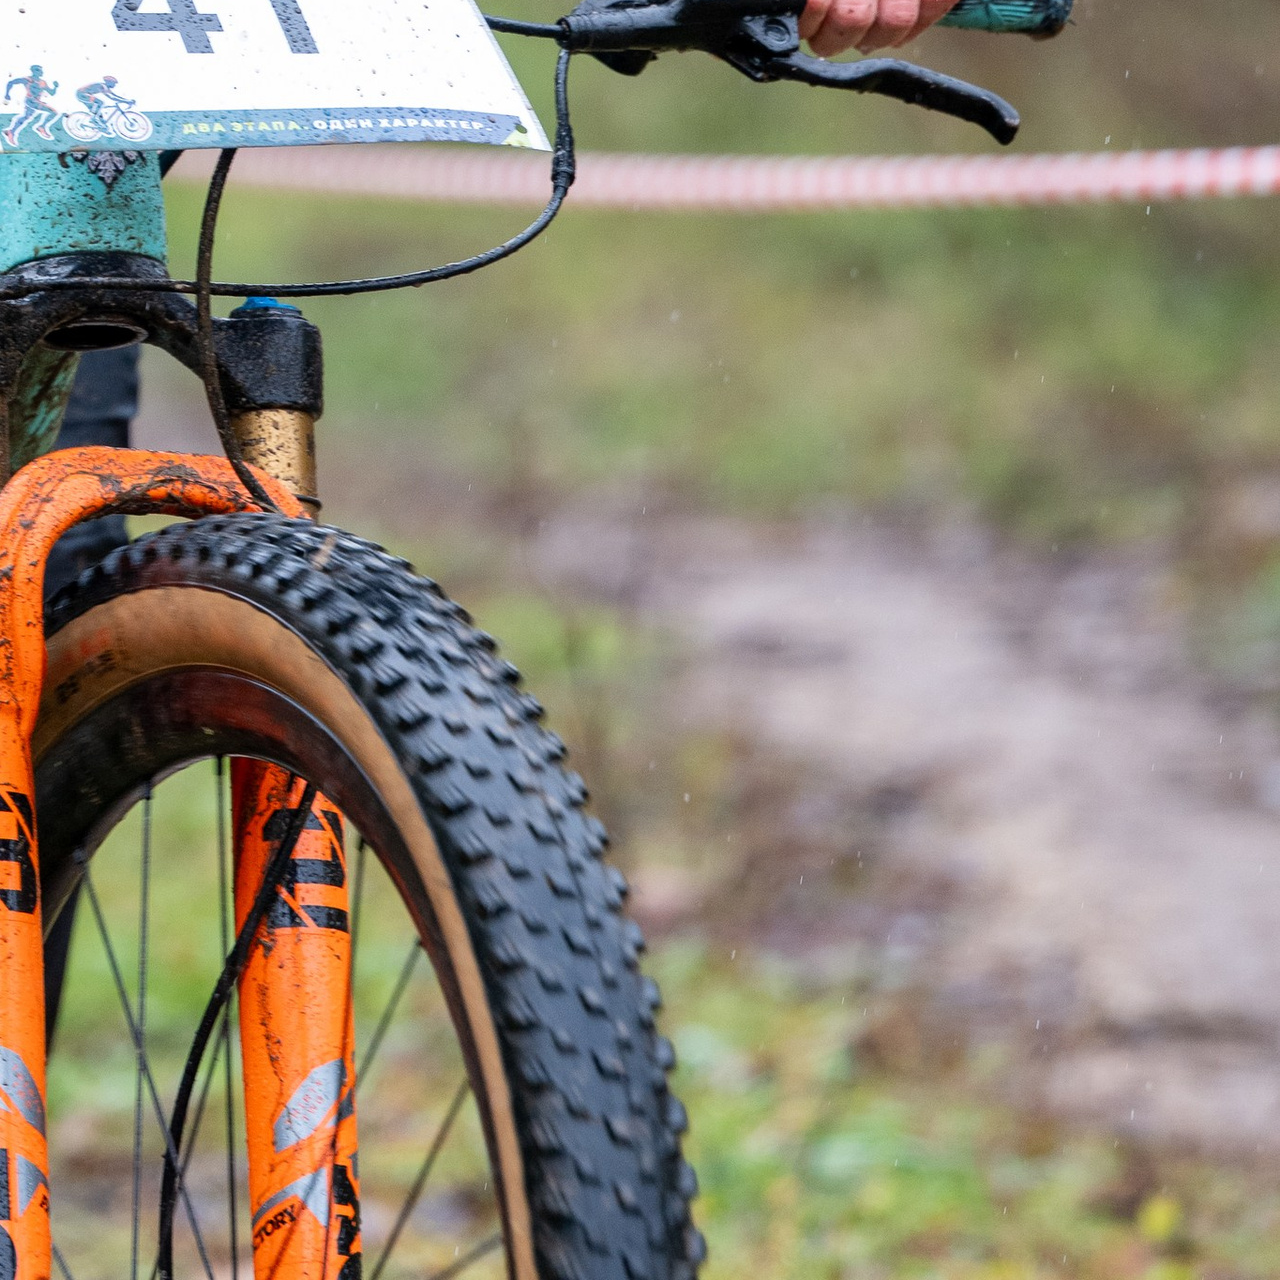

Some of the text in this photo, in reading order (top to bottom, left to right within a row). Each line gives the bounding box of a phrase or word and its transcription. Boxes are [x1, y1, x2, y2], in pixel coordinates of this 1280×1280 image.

[181, 117, 493, 136] ДВА ЭТАПА. ОДИН ХАРАКТЕР.
